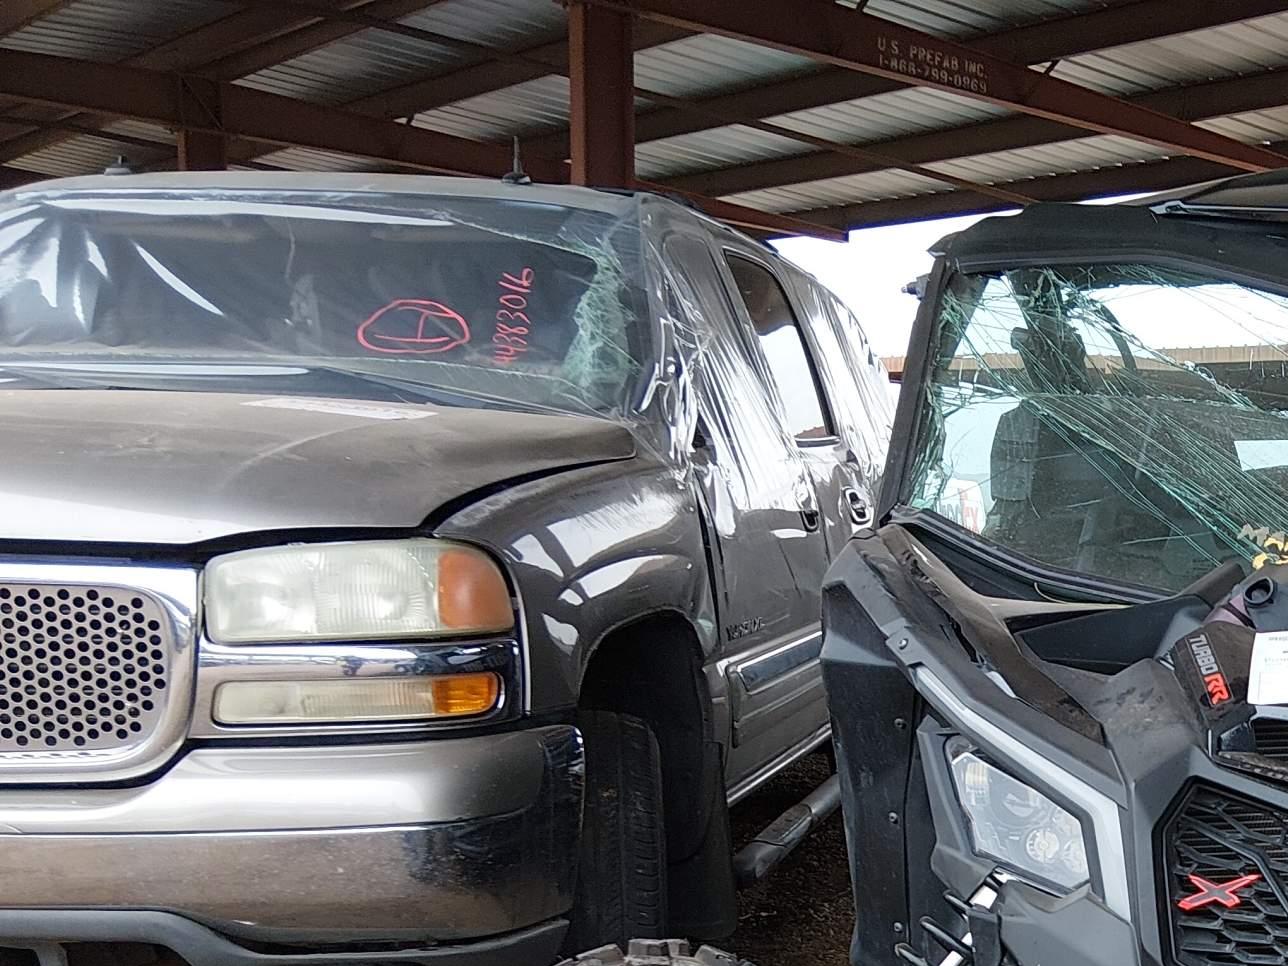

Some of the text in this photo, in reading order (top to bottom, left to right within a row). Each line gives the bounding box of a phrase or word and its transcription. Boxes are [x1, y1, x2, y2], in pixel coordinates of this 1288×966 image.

[909, 45, 959, 71] PREFAB
[964, 60, 988, 79] INC.
[1187, 634, 1229, 705] TURBO RR
[1178, 874, 1262, 910] X
